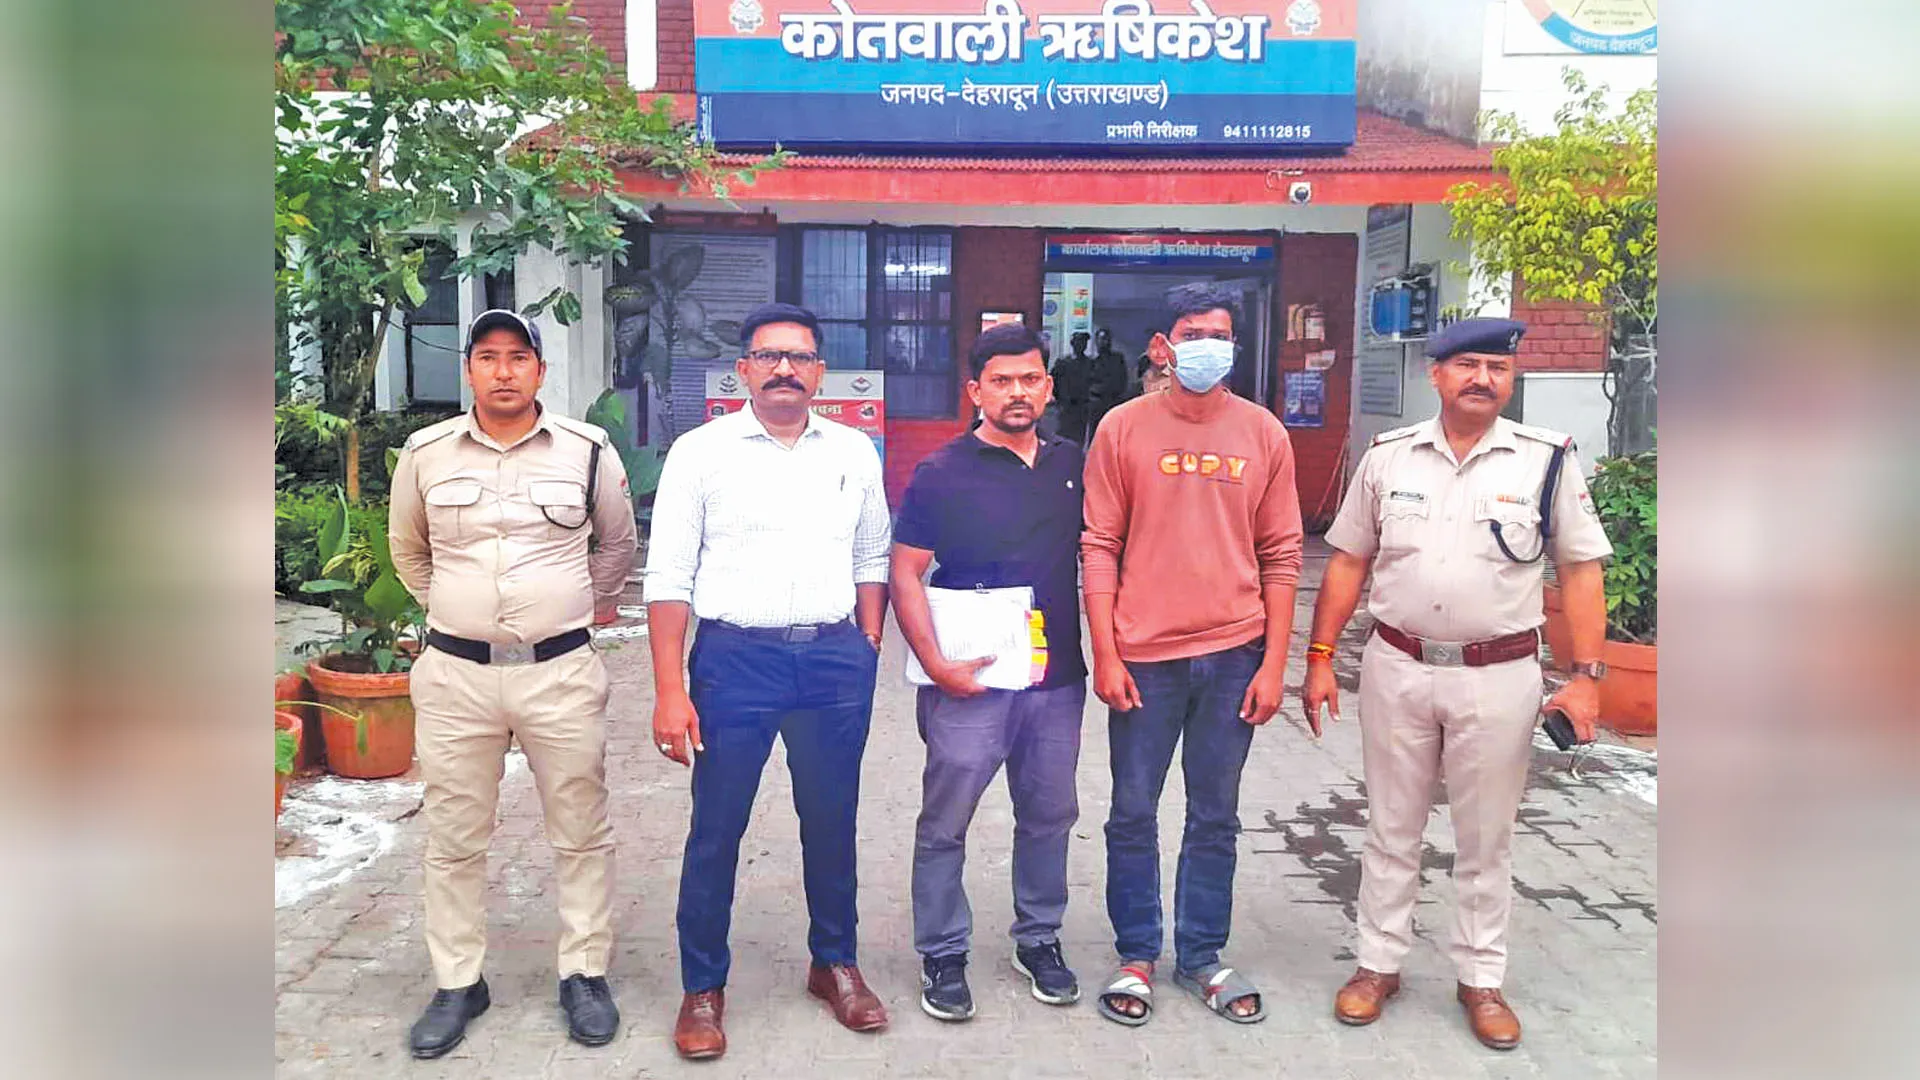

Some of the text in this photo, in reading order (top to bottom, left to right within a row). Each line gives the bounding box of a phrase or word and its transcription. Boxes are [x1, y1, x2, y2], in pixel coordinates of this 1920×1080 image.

[779, 0, 1270, 65] कोतवाली ऋषिकेश
[1046, 78, 1169, 110] (उत्तराखण्ड)
[1106, 120, 1311, 139] प्रभारी निरीक्षक 9411112815
